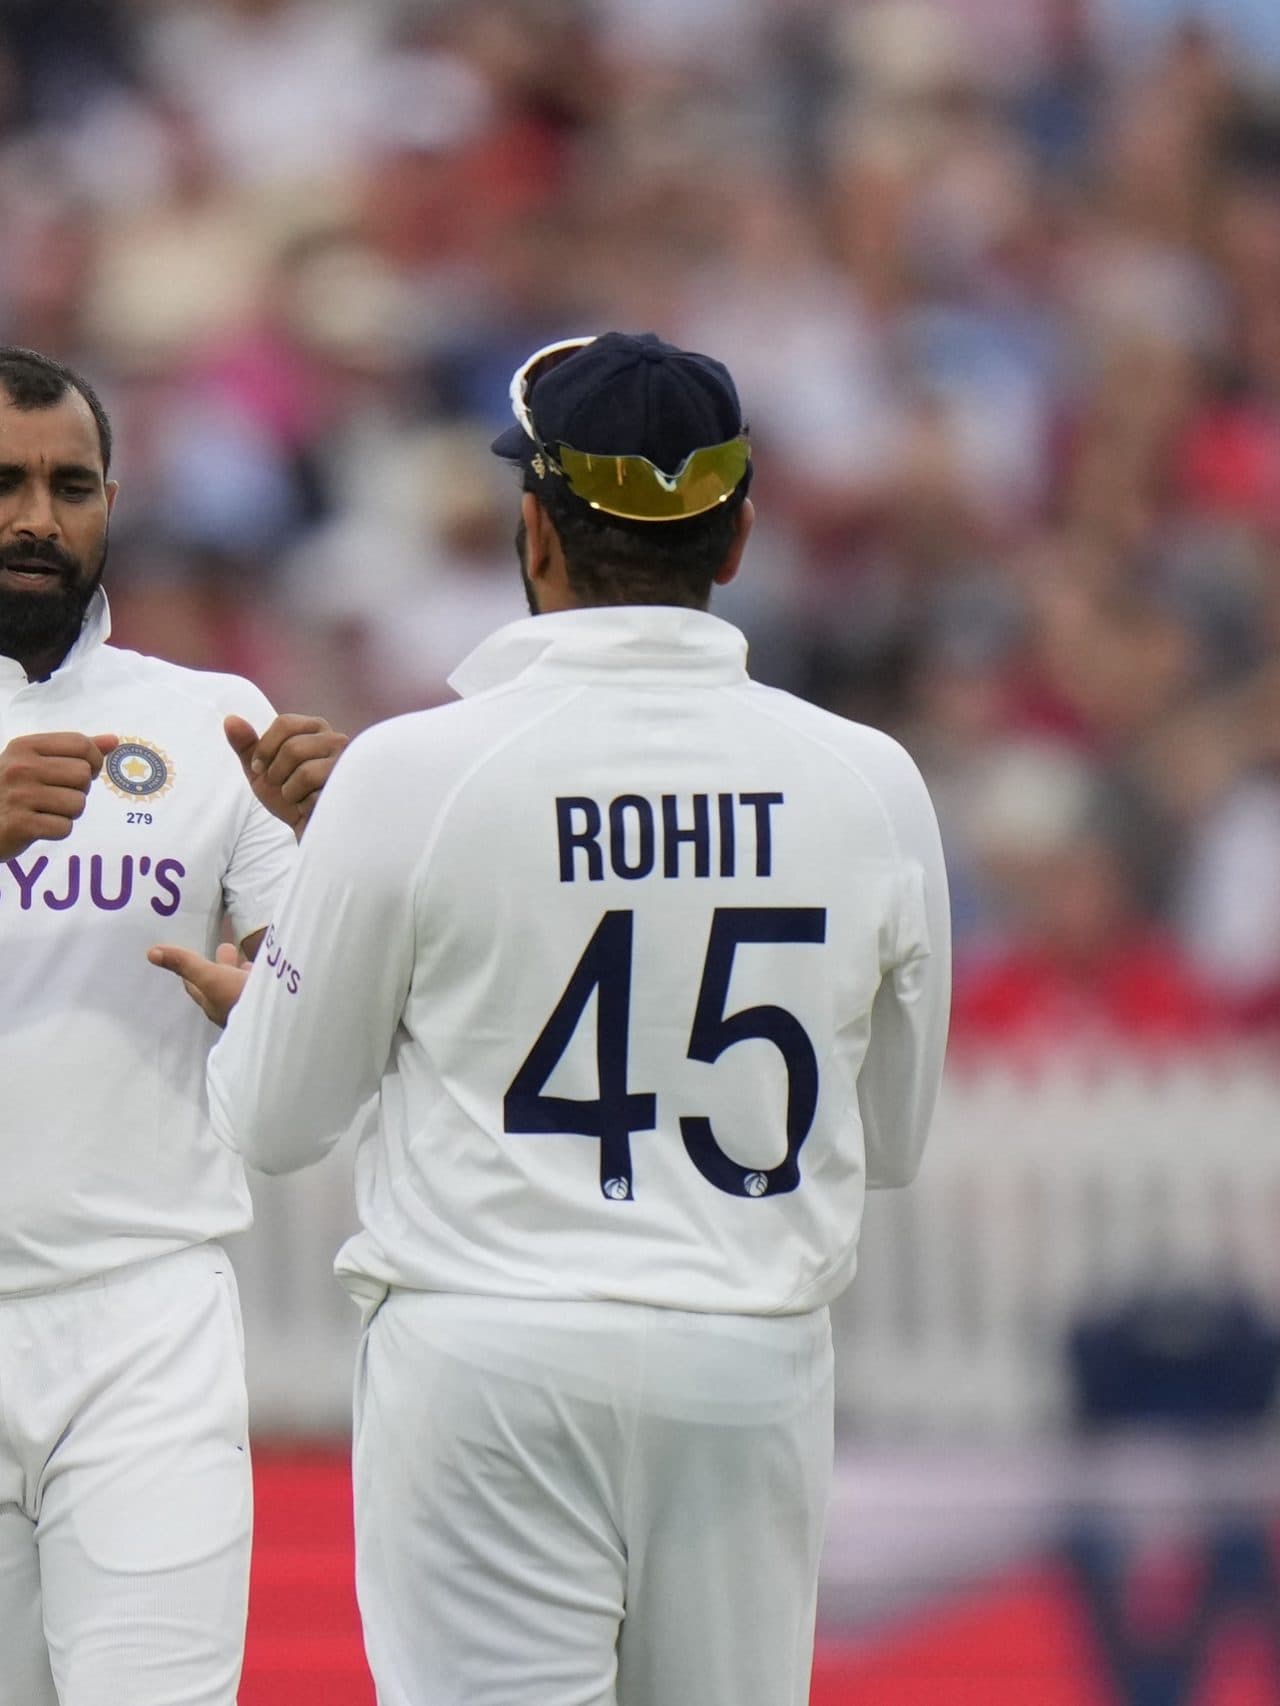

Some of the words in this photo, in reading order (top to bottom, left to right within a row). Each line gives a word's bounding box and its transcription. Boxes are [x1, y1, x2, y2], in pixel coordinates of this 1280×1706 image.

[126, 812, 153, 825] 279
[555, 792, 784, 882] ROHIT
[503, 907, 827, 1201] 45
